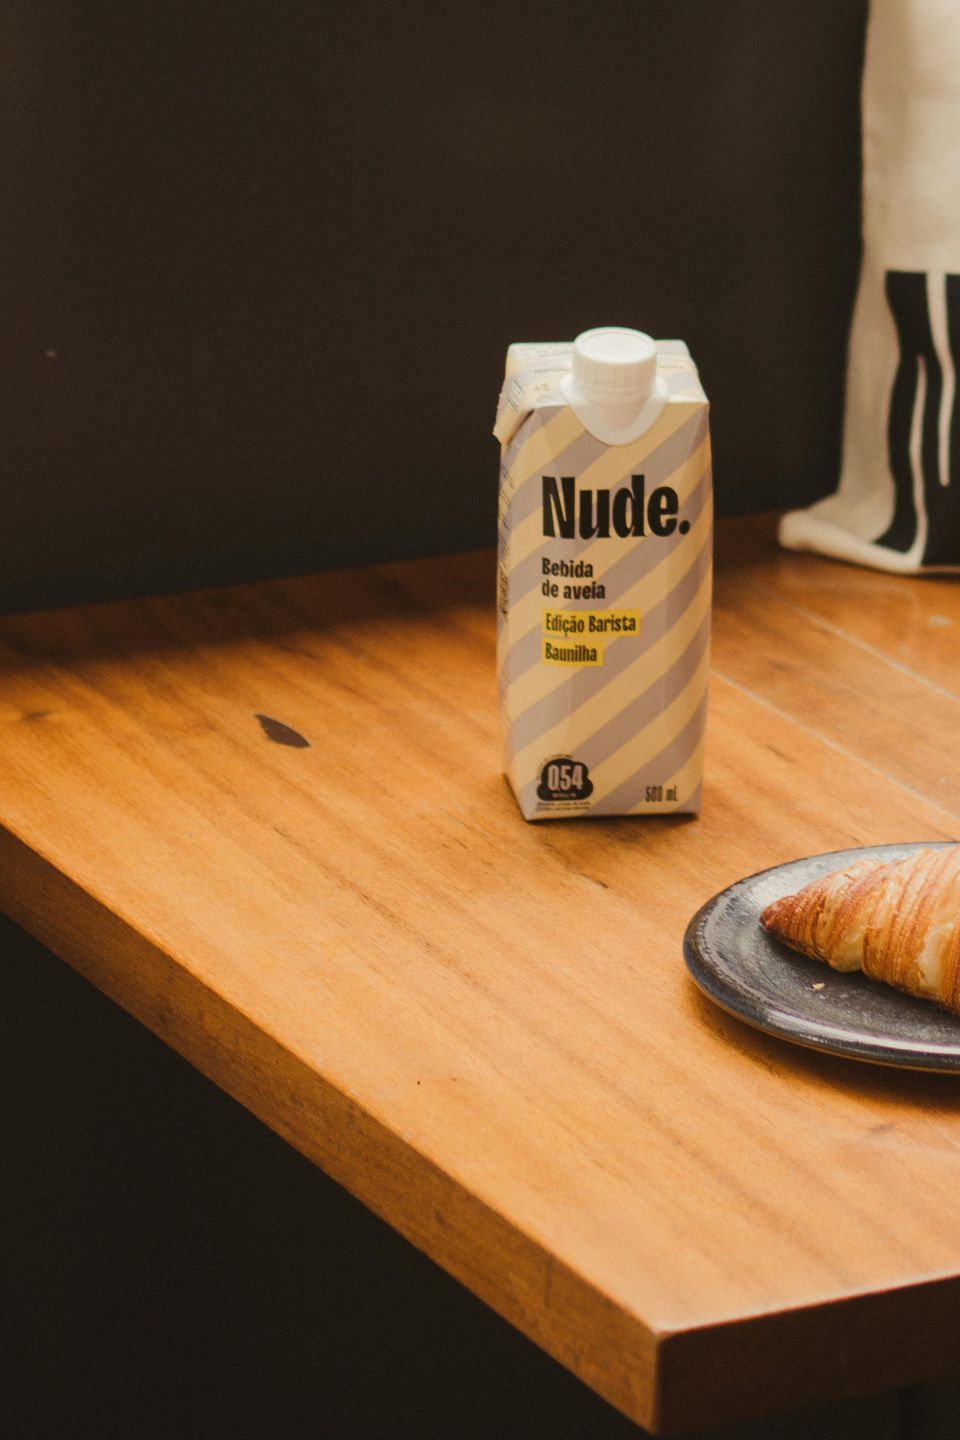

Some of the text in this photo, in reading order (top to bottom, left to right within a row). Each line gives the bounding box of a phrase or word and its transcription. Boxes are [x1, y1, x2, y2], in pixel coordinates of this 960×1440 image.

[541, 473, 691, 540] Nude.
[541, 557, 593, 578] Bebida
[541, 579, 605, 600] de aveia
[546, 613, 636, 637] Edição Barista
[545, 642, 597, 662] Baunilha
